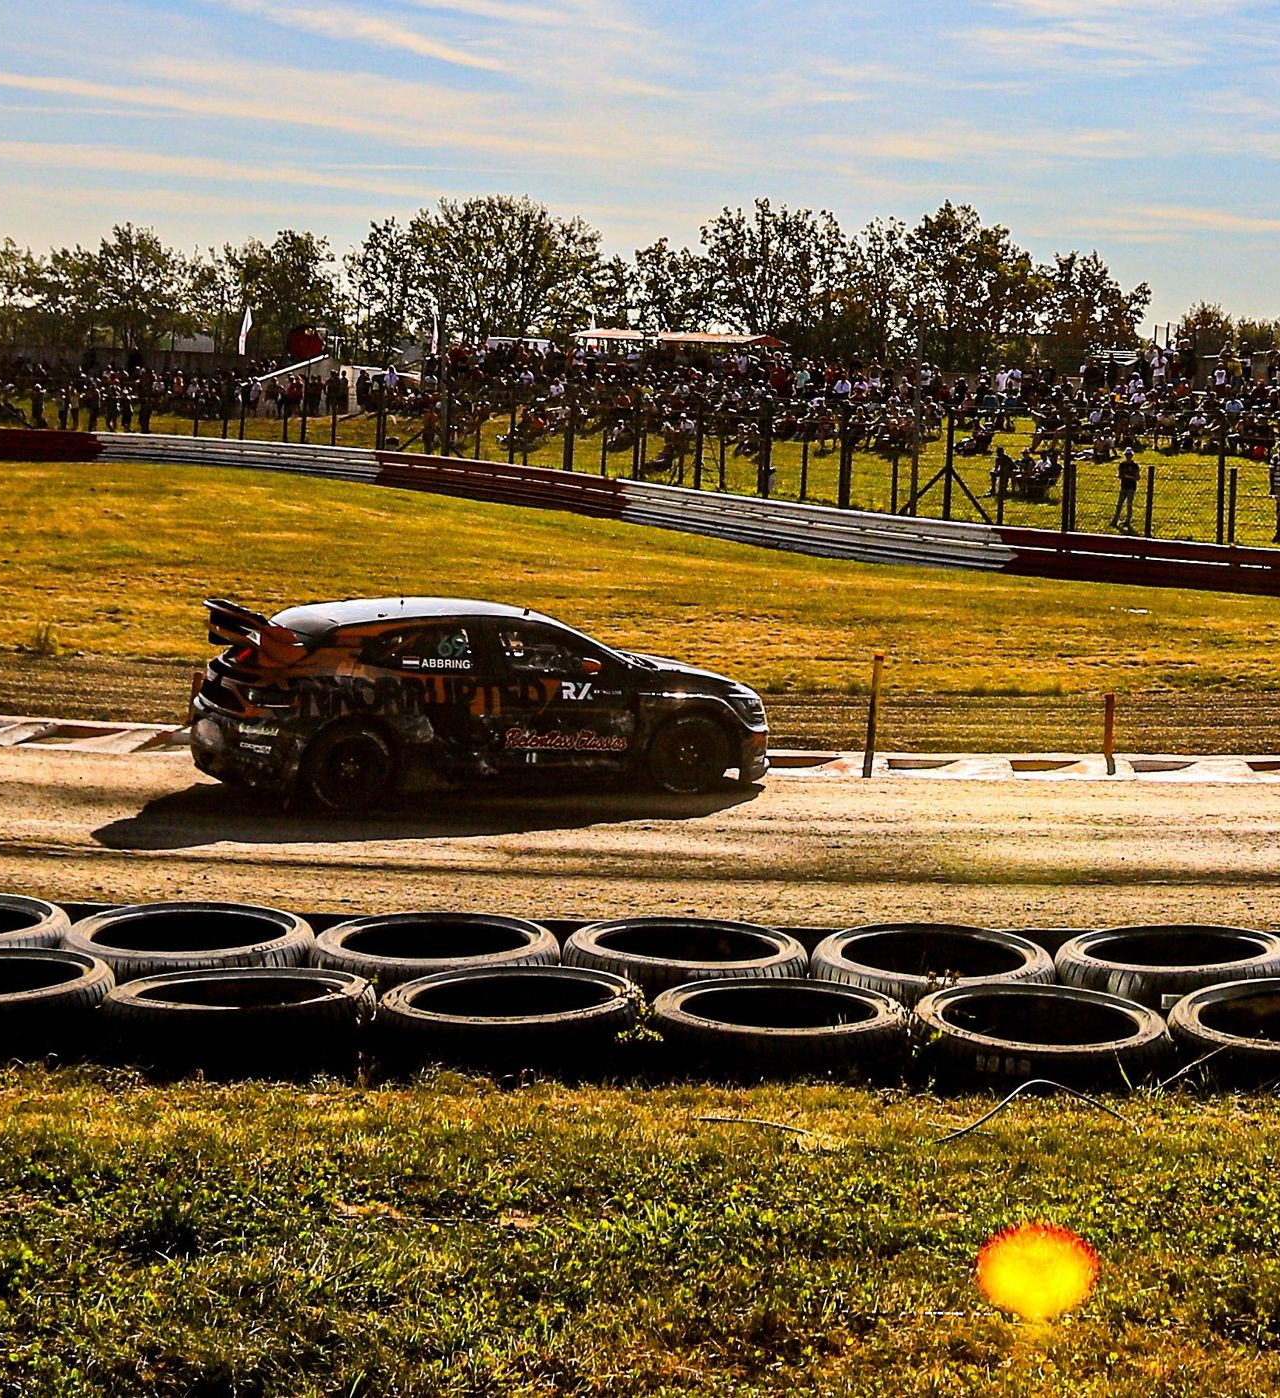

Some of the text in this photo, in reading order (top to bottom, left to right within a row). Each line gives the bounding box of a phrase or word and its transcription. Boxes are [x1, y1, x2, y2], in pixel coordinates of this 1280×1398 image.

[437, 634, 467, 656] 69
[421, 658, 471, 669] ABBRING
[561, 681, 594, 700] RX
